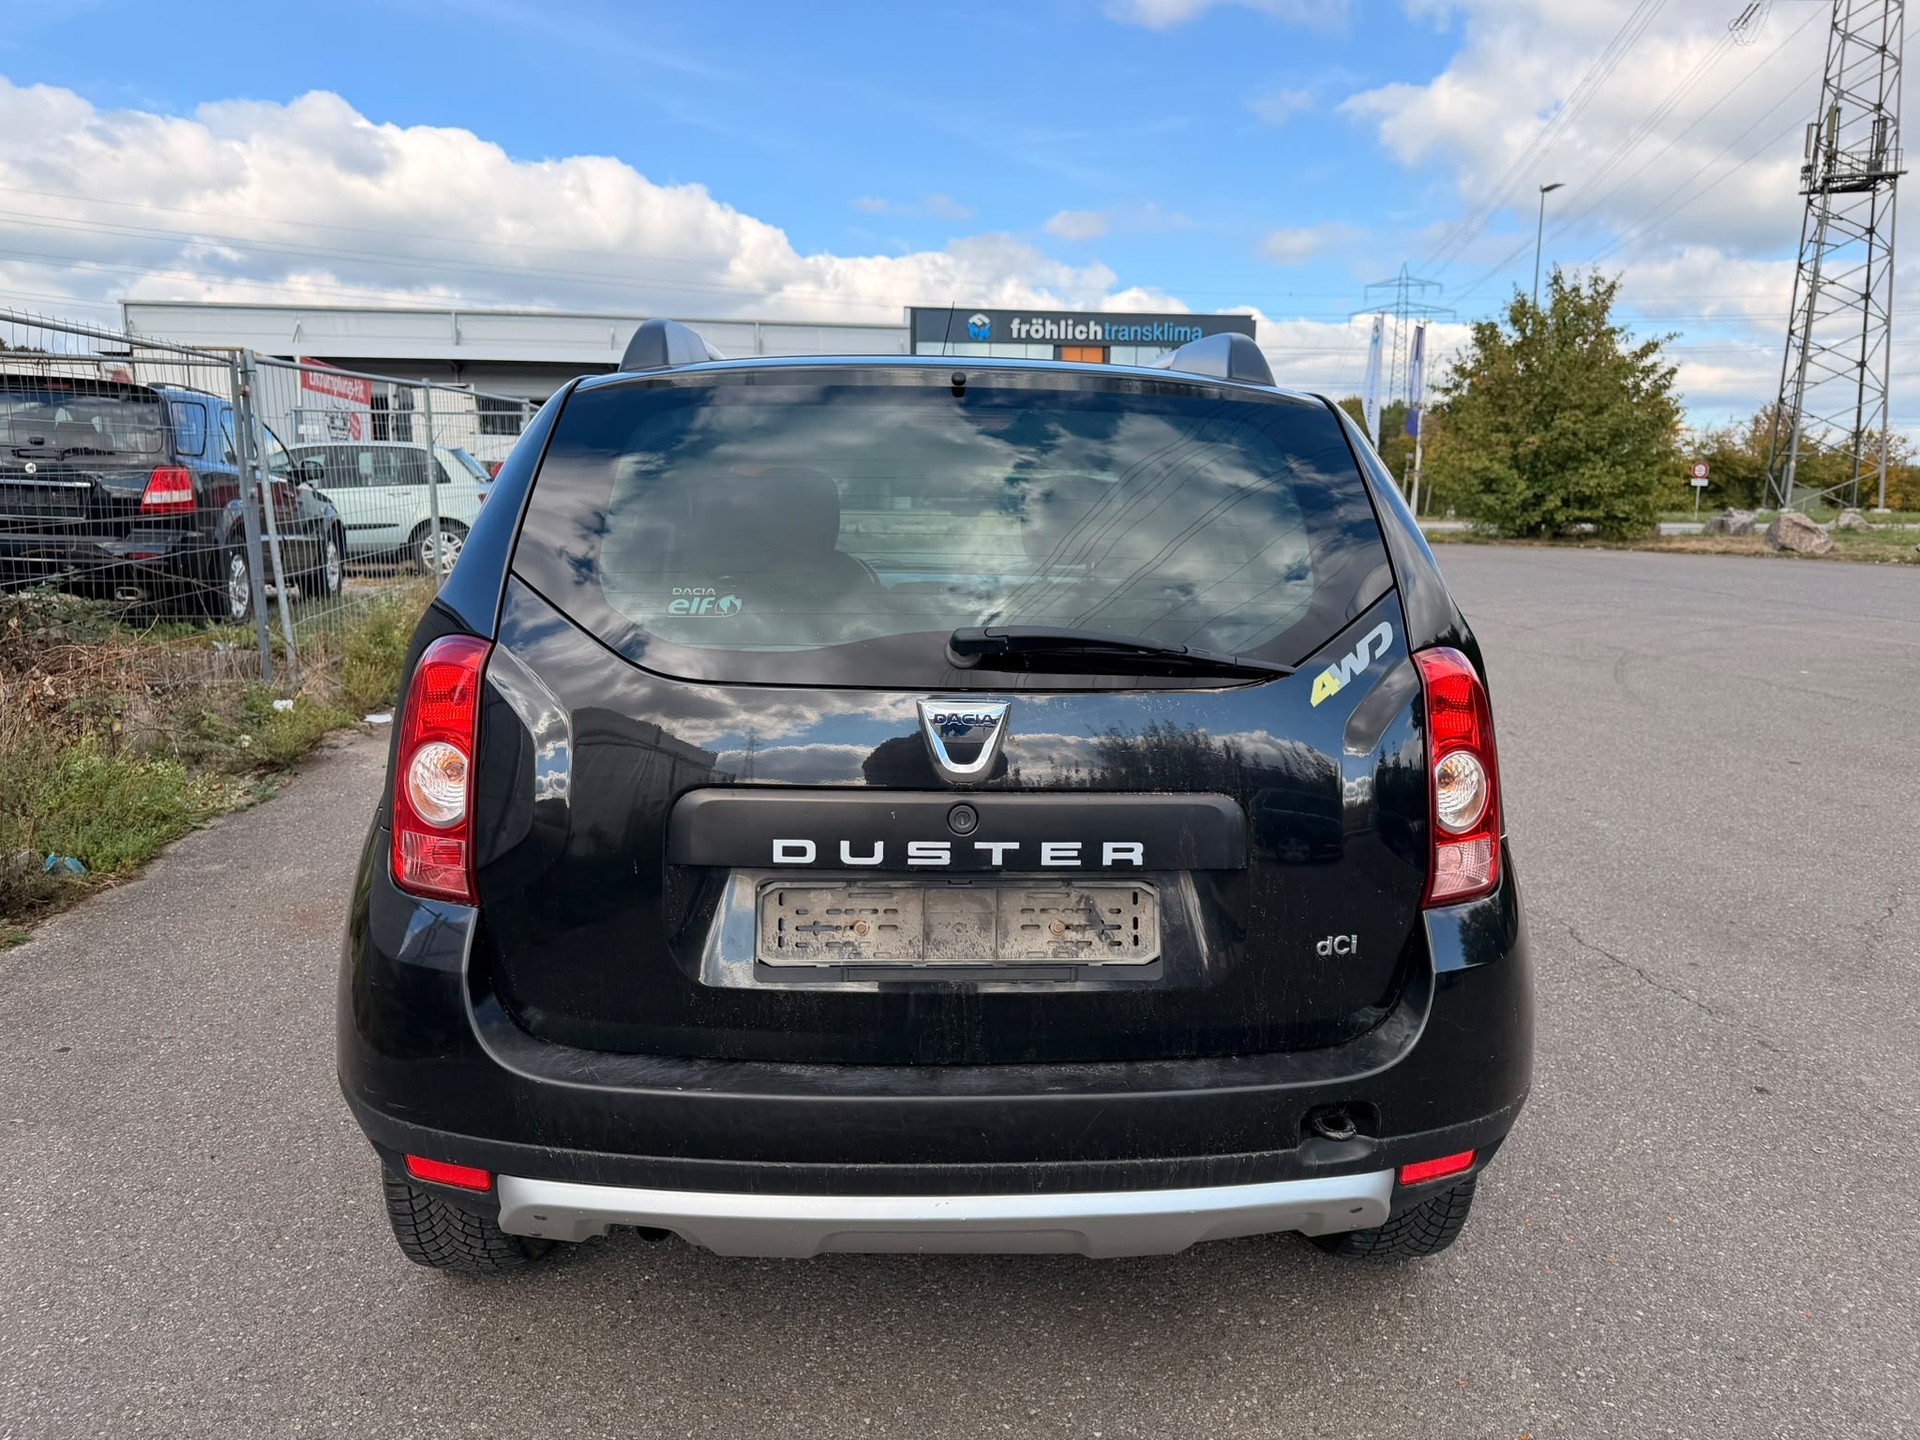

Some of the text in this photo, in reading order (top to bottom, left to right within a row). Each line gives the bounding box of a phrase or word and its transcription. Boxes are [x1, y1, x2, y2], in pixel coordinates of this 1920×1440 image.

[672, 587, 717, 596] DACIA
[667, 597, 716, 615] elf
[1310, 621, 1393, 708] 4WD
[933, 713, 997, 726] DACIA
[772, 838, 1144, 866] DUSTER
[1316, 934, 1358, 957] dCi
